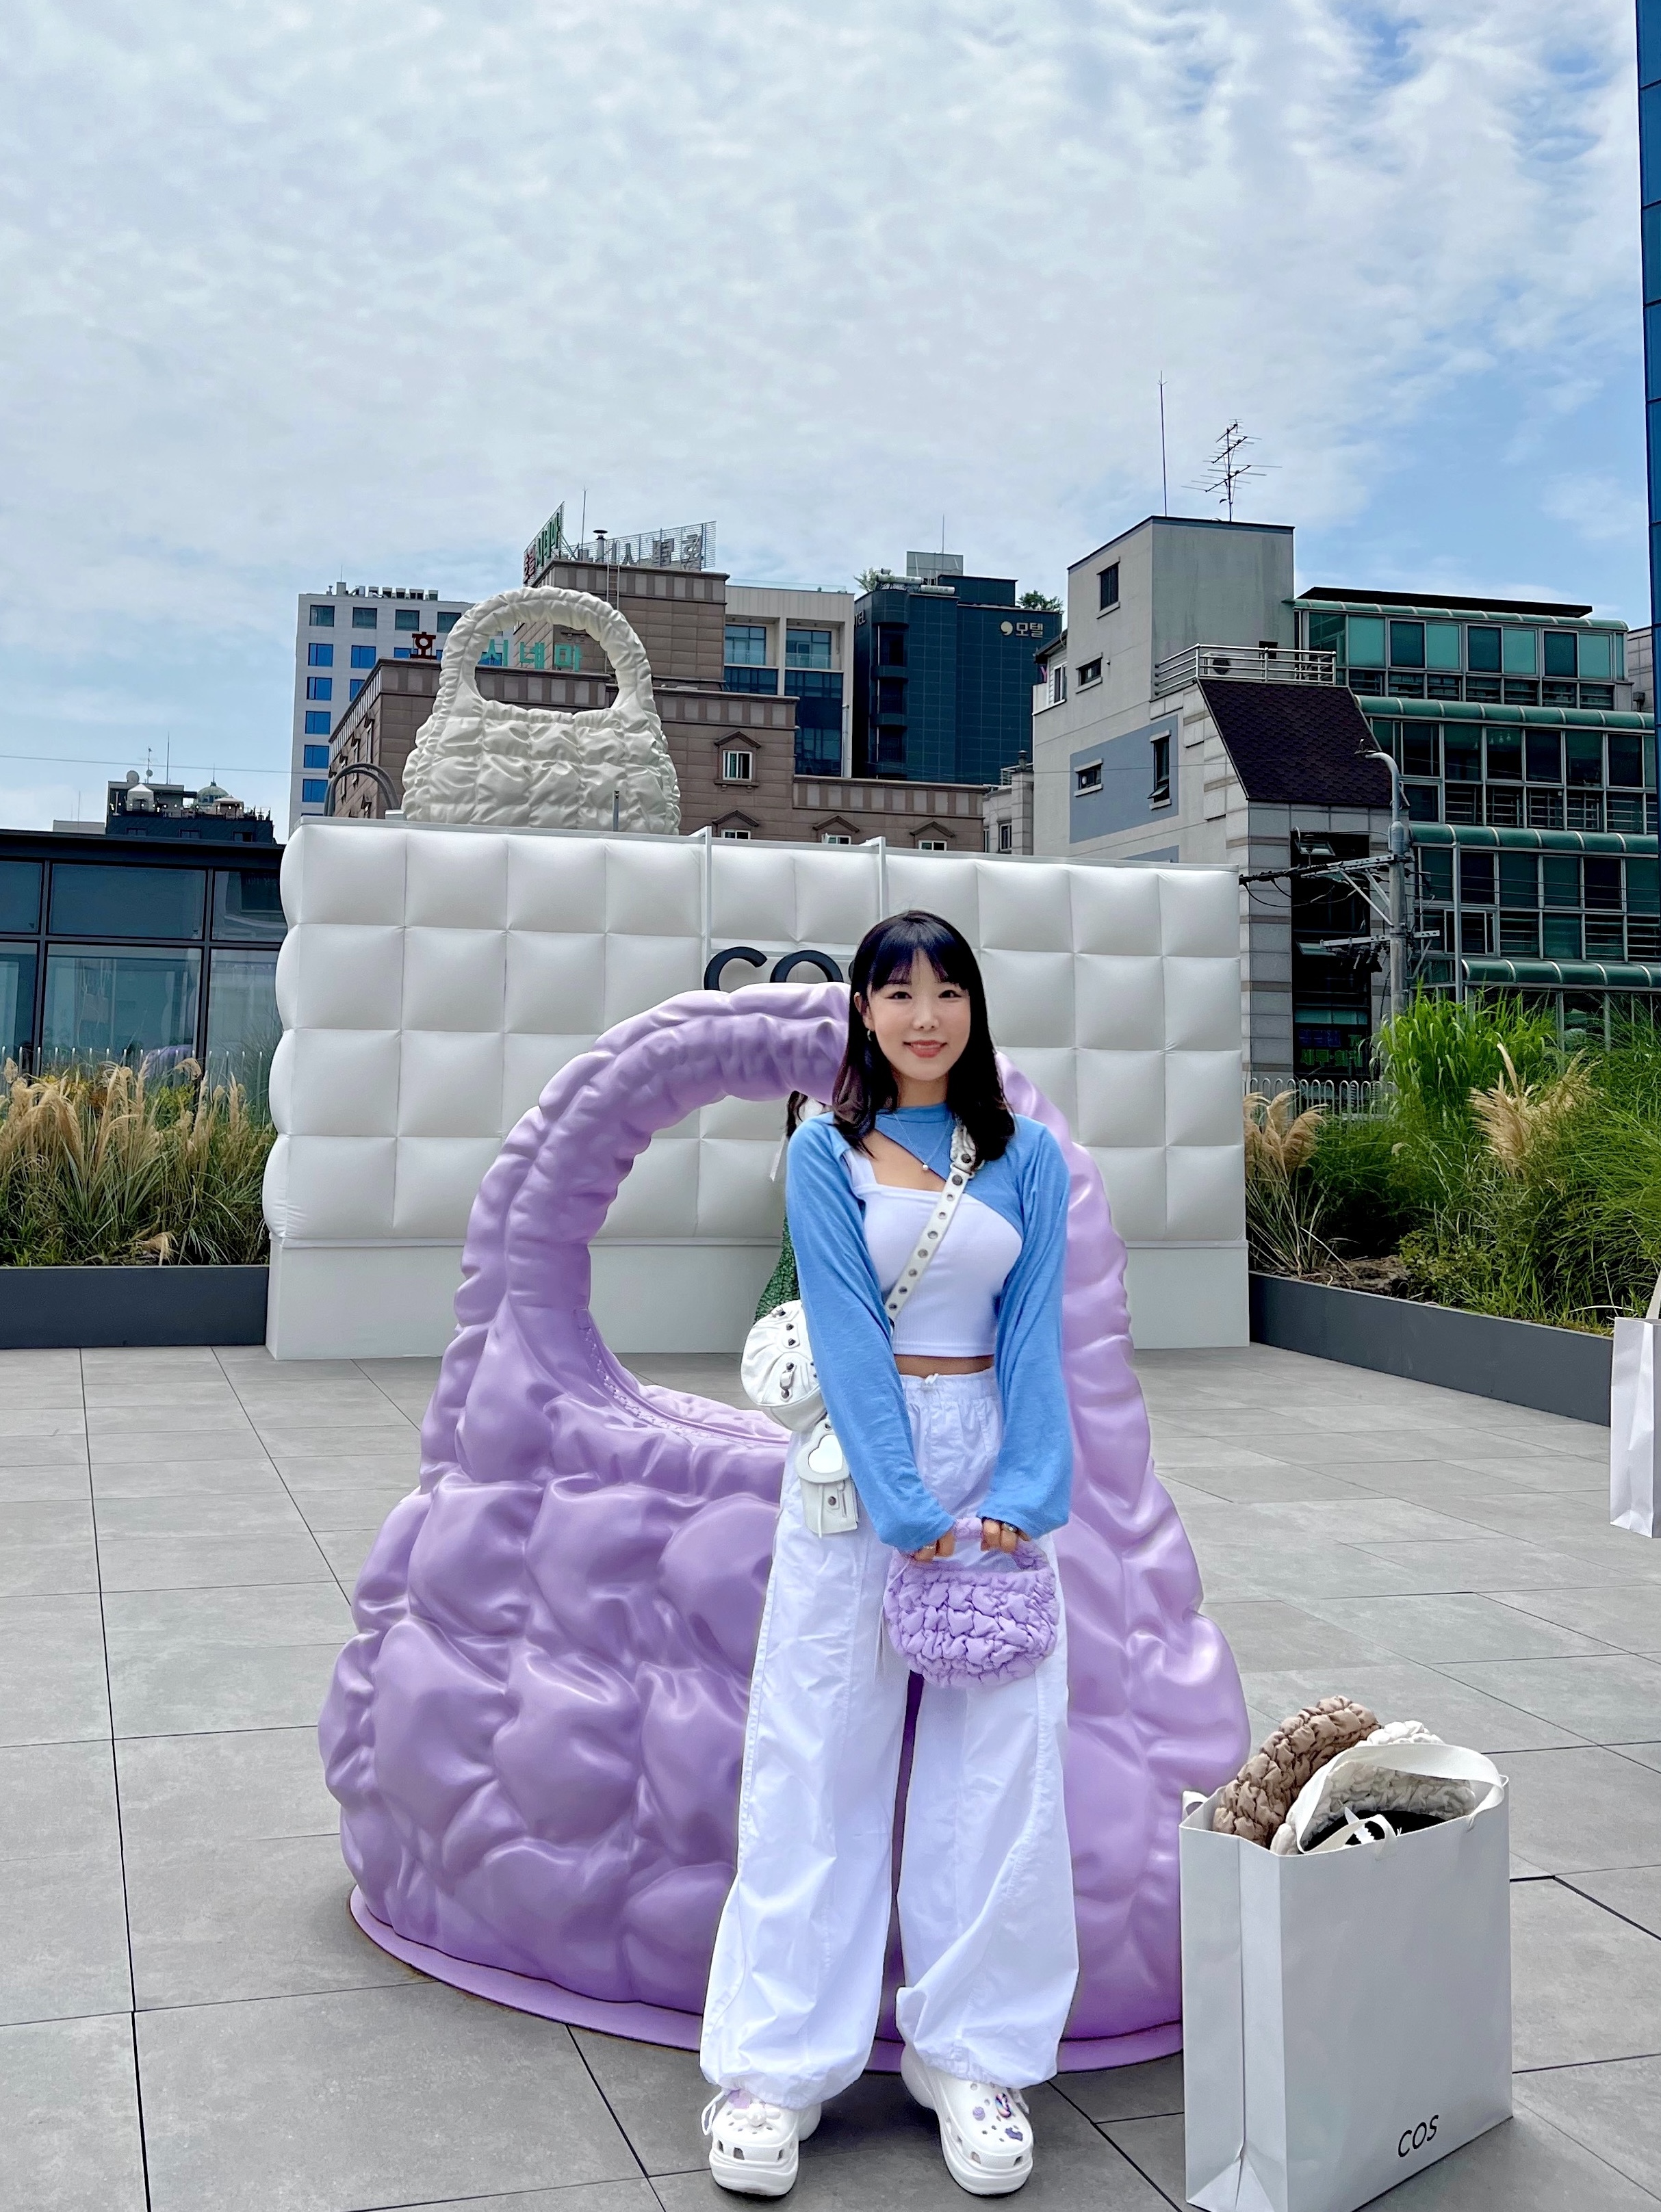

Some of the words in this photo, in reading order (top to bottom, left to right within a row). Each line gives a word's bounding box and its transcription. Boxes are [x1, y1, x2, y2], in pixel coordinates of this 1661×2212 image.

[855, 610, 866, 627] TEL
[1016, 622, 1044, 638] 모텔
[411, 632, 437, 660] 호
[480, 639, 582, 673] 시네마
[1398, 2114, 1439, 2158] COS
